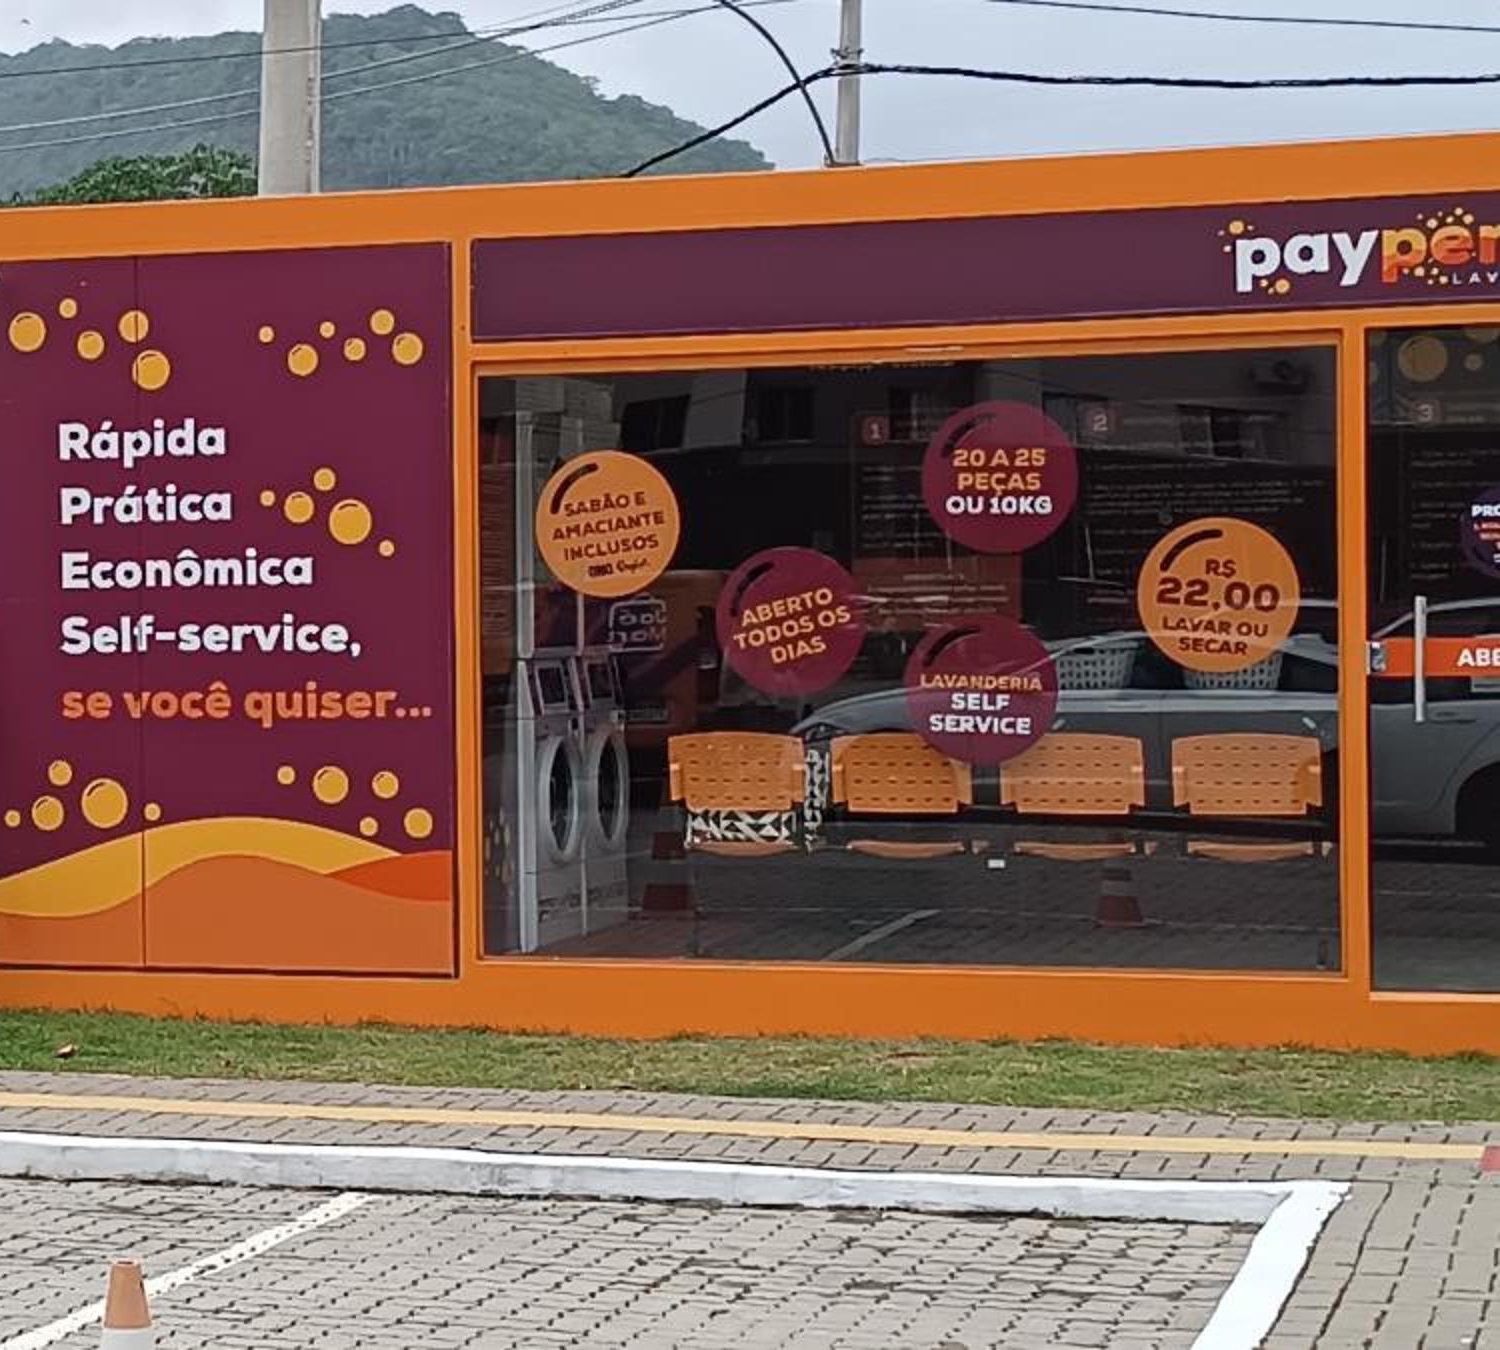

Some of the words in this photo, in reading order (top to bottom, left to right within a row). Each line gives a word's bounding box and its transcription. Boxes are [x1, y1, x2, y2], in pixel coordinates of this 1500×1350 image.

[1092, 414, 1108, 432] 2
[1417, 403, 1433, 422] 3
[58, 417, 226, 469] Rápida
[952, 448, 985, 467] 20
[989, 448, 1010, 467] A
[1014, 448, 1046, 467] 25
[957, 472, 1041, 497] PEÇAS
[60, 484, 232, 525] Prática
[564, 492, 630, 517] SABÃO
[634, 491, 646, 506] E
[945, 496, 984, 514] OU
[989, 496, 1053, 514] 10KG
[552, 511, 665, 541] AMACIANTE
[563, 534, 659, 561] INCLUSOS
[60, 547, 314, 589] Econômica
[741, 587, 833, 628] ABERTO
[60, 613, 361, 657] Self-service,
[733, 618, 815, 650] TODOS
[817, 605, 852, 629] OS
[1162, 616, 1232, 636] LAVAR
[1236, 621, 1269, 637] OU
[770, 635, 827, 665] DIAS
[1178, 636, 1249, 656] SECAR
[1457, 647, 1500, 667] ABE
[919, 673, 1043, 691] LAVANDERIA
[61, 690, 113, 719] se
[122, 681, 232, 719] você
[244, 680, 432, 729] quiser...
[951, 693, 1011, 712] SELF
[930, 714, 1032, 735] SERVICE
